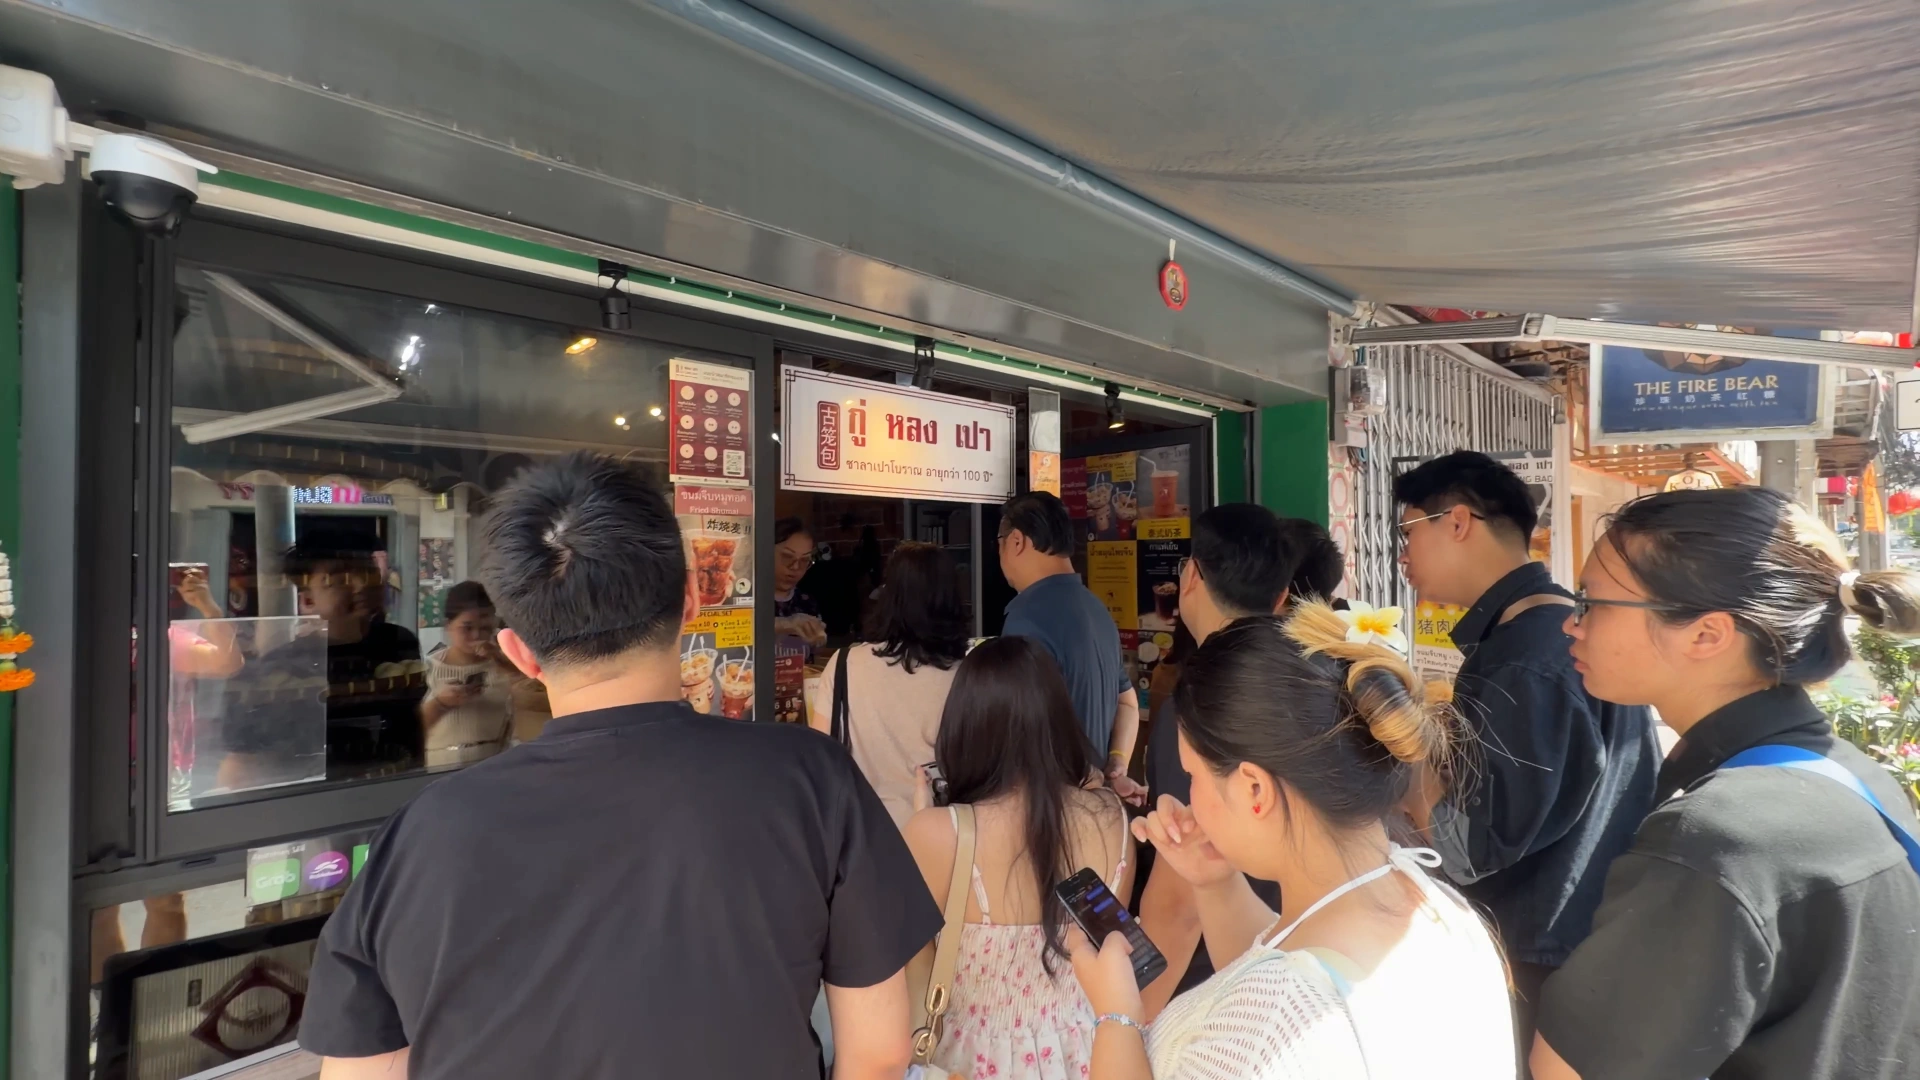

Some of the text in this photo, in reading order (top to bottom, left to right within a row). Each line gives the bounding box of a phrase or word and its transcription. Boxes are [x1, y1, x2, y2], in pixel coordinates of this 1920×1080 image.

[1634, 375, 1779, 396] THE FIRE BEAR
[848, 399, 991, 452] กู่ หลง เปา
[820, 406, 838, 466] 古笼包
[926, 467, 960, 483] อายุกว่า
[963, 469, 981, 482] 100
[690, 506, 739, 515] Fried Shumai
[1418, 618, 1459, 635] 猪肉
